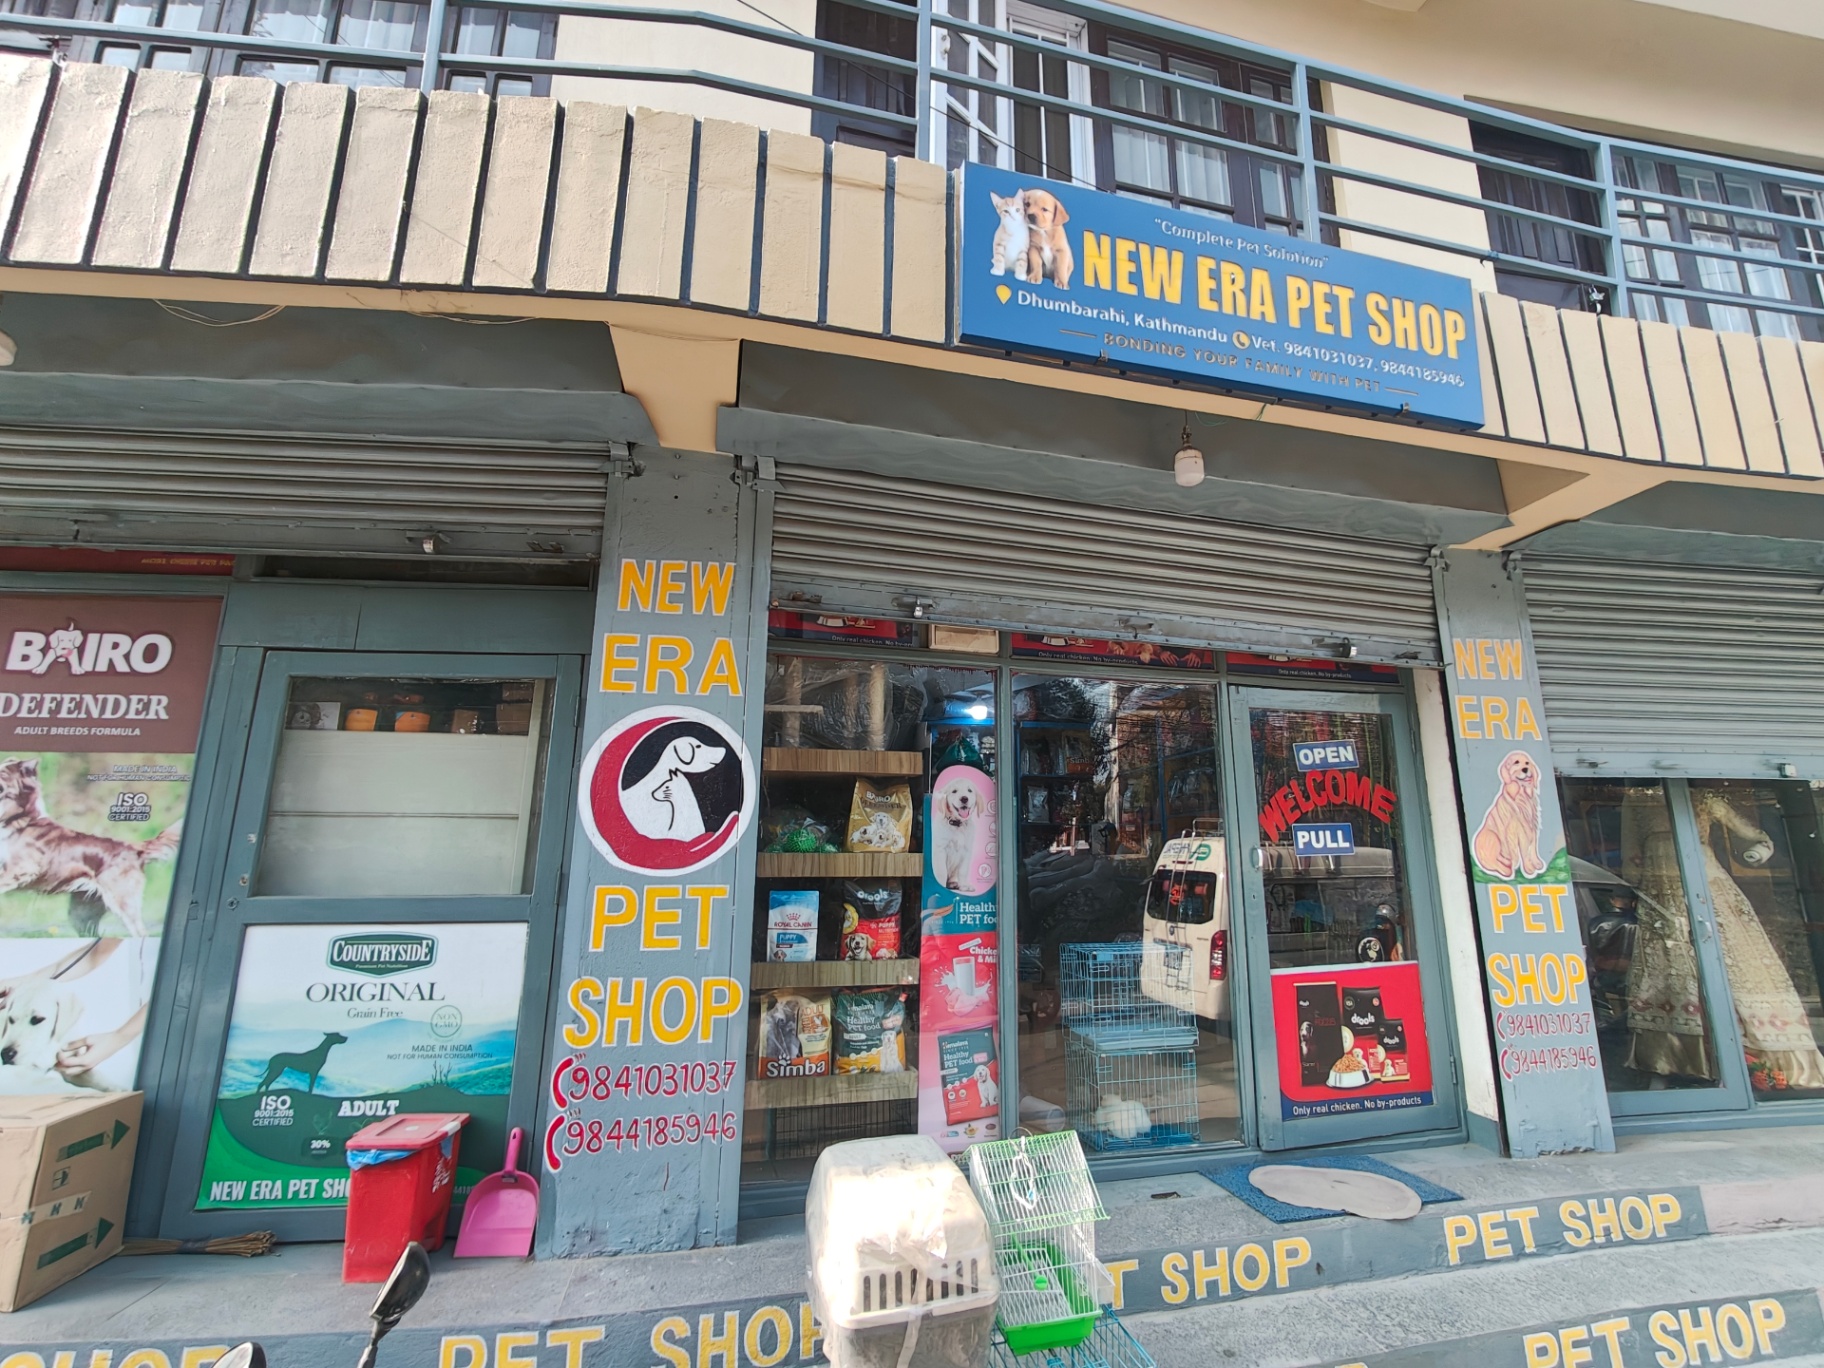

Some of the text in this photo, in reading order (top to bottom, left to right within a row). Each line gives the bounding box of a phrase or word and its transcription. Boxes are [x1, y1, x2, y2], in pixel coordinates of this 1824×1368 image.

[1236, 237, 1261, 255] Pet
[1082, 229, 1467, 360] NEW ERA PET SHOP
[1017, 289, 1130, 327] Dhumbarahi,
[1134, 311, 1228, 344] Kathmandu
[1380, 359, 1465, 388] 9844185946
[1103, 332, 1381, 393] BONDING YOUR FAMILY WITH PET
[617, 558, 736, 616] NEW
[5, 629, 173, 676] BAIRO
[1453, 637, 1523, 681] NEW
[599, 633, 743, 696] ERA
[0, 692, 170, 720] DEFENDER
[1455, 695, 1543, 741] ERA
[14, 726, 141, 737] ADULT BREEDS FORMULA
[1298, 745, 1355, 766] OPEN
[112, 765, 177, 774] MADE IN INDIA
[118, 793, 148, 806] ISO
[1258, 769, 1398, 844] WELCOME
[108, 813, 150, 821] CERTIFIED
[1296, 830, 1350, 849] PULL
[589, 884, 730, 952] PET
[959, 914, 982, 925] PET
[1488, 883, 1568, 933] PET
[332, 940, 433, 963] COUNTRYSIDE
[1487, 952, 1587, 1008] SHOP
[305, 982, 446, 1003] ORIGINAL
[346, 1006, 404, 1019] Grain Free
[435, 1012, 458, 1020] NON
[563, 975, 744, 1048] SHOP
[847, 1015, 876, 1026] Healthy
[1351, 1012, 1375, 1026] drools
[864, 1021, 881, 1031] food
[1505, 1012, 1592, 1039] 9841031037
[411, 1043, 473, 1053] MADE IN INDIA
[443, 1052, 493, 1060] CONSUMPTION
[943, 1051, 970, 1062] Healthy
[766, 1059, 826, 1078] Simba
[944, 1060, 958, 1069] PET
[958, 1057, 973, 1067] food
[1510, 1045, 1598, 1076] 9844185946
[568, 1060, 738, 1103] 9841031037
[260, 1095, 292, 1111] ISO
[337, 1099, 400, 1117] ADULT
[1293, 1095, 1422, 1116] Only real chicken. No by-products
[252, 1117, 294, 1127] CERTIFIED
[562, 1111, 738, 1157] 9844185946
[209, 1180, 247, 1202] NEW
[250, 1179, 283, 1200] ERA
[287, 1178, 320, 1199] PET
[1443, 1192, 1682, 1266] PET SHOP
[1160, 1236, 1312, 1304] SHOP
[1523, 1298, 1787, 1368] PET SHOP
[439, 1325, 606, 1368] PET
